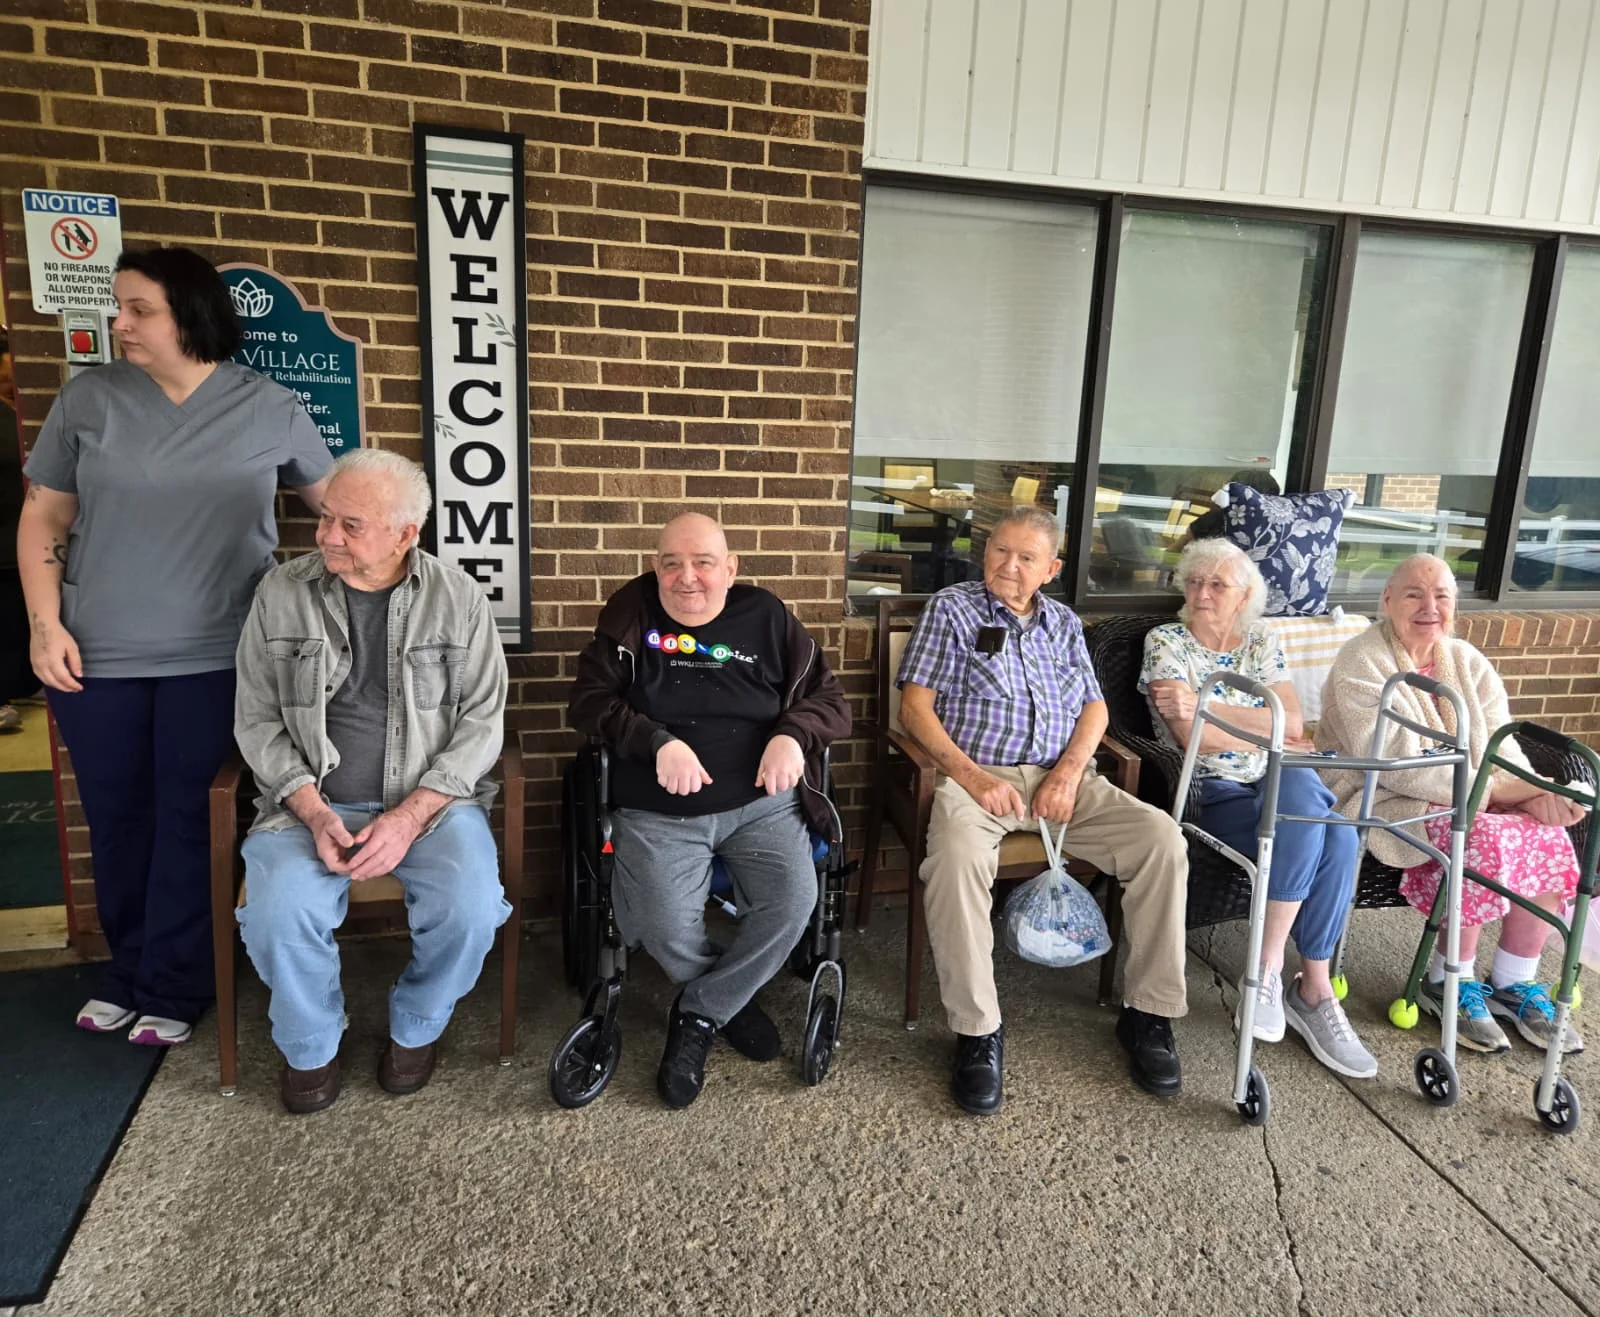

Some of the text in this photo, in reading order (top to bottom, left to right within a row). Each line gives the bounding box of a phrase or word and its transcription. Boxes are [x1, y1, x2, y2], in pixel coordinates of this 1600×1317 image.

[31, 193, 110, 214] NOTICE
[43, 262, 110, 274] NO FIREARMS
[45, 273, 111, 285] OR WEAPONS
[48, 284, 111, 295] ALLOWED ON
[43, 295, 116, 307] THIS PROPERTY
[243, 330, 298, 343] ome to
[241, 345, 341, 371] VILLAGE
[275, 371, 352, 384] Rehabilitation
[293, 388, 311, 401] he
[432, 186, 515, 602] WELCOME
[306, 403, 331, 414] ter.
[317, 422, 341, 434] nal
[323, 437, 344, 447] se
